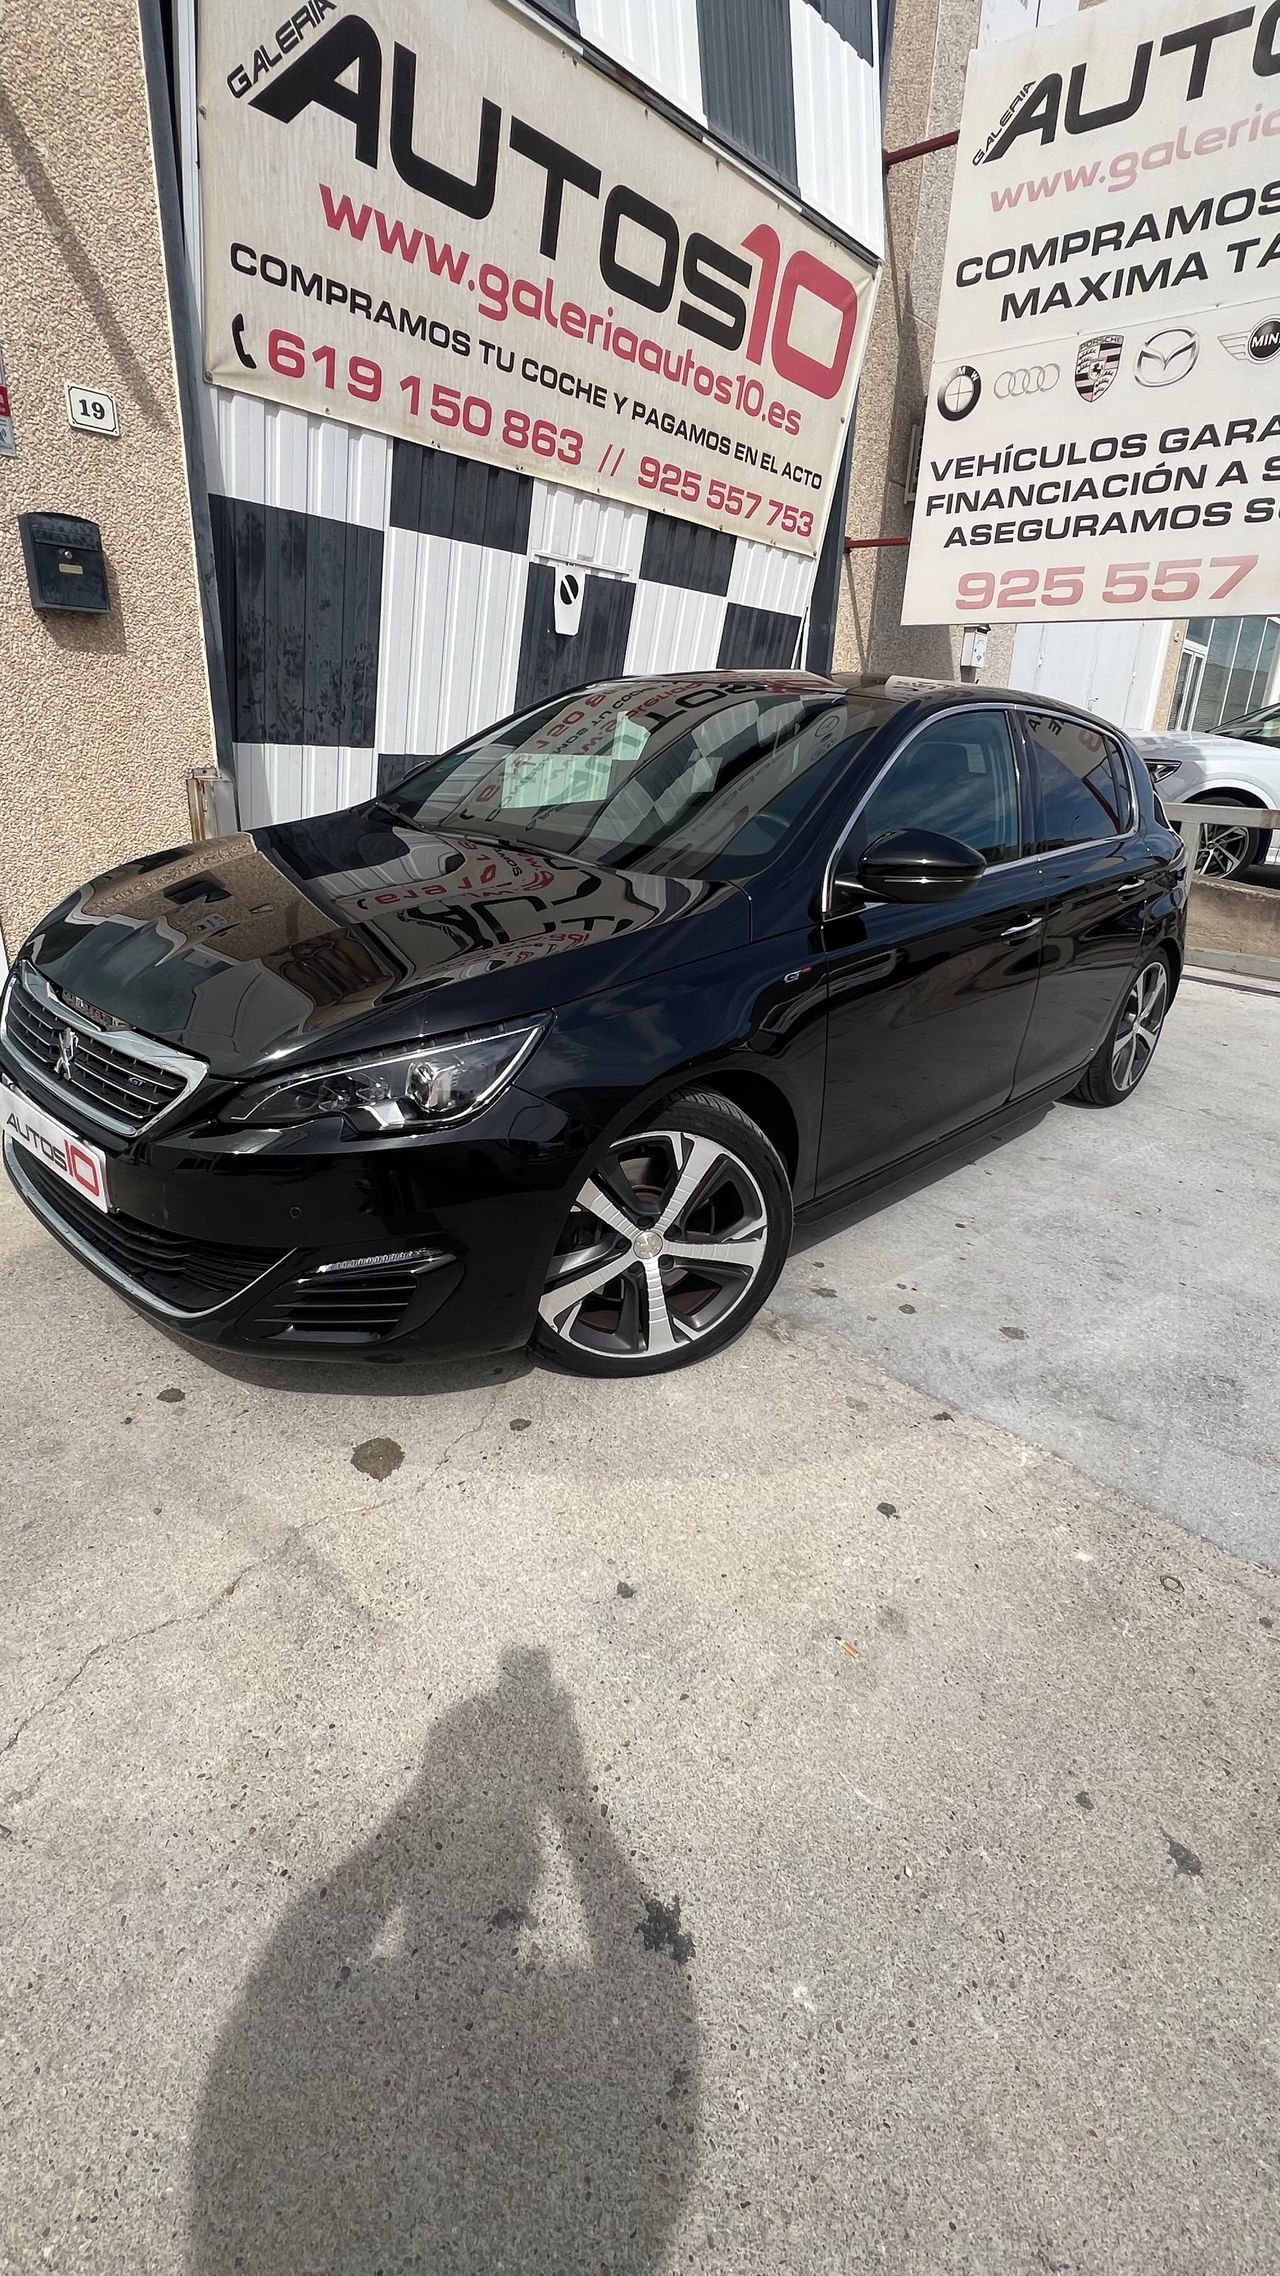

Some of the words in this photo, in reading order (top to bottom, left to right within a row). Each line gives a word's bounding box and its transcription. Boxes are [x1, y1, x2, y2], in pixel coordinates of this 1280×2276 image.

[226, 0, 338, 99] GALERIA
[972, 80, 1037, 166] GALERIA
[248, 14, 858, 401] AUTOS10
[318, 183, 802, 437] www.galeriaautos10.es
[1000, 251, 1208, 321] MAXIMA
[230, 242, 471, 357] COMPRAMOS
[478, 339, 515, 373] TU
[521, 357, 607, 409] COCHE
[613, 392, 629, 415] Y
[631, 400, 731, 456] PAGAMOS
[734, 441, 758, 466] EN
[760, 455, 778, 474] EL
[781, 461, 823, 490] ACTO
[1251, 332, 1280, 348] MIN
[78, 398, 105, 420] 19
[268, 328, 383, 402] 619
[399, 375, 493, 438] 150
[502, 408, 583, 466] 863
[637, 455, 702, 503] 925
[706, 478, 762, 520] 557
[766, 499, 814, 538] 753
[926, 461, 1208, 517] FINANCIACIÓN
[1215, 460, 1249, 488] A
[930, 432, 1147, 482] VEHÍCULOS
[944, 502, 1232, 549] ASEGURAMOS
[956, 567, 1086, 610] 925
[1102, 555, 1259, 603] 557
[6, 1113, 100, 1197] AUTOS10
